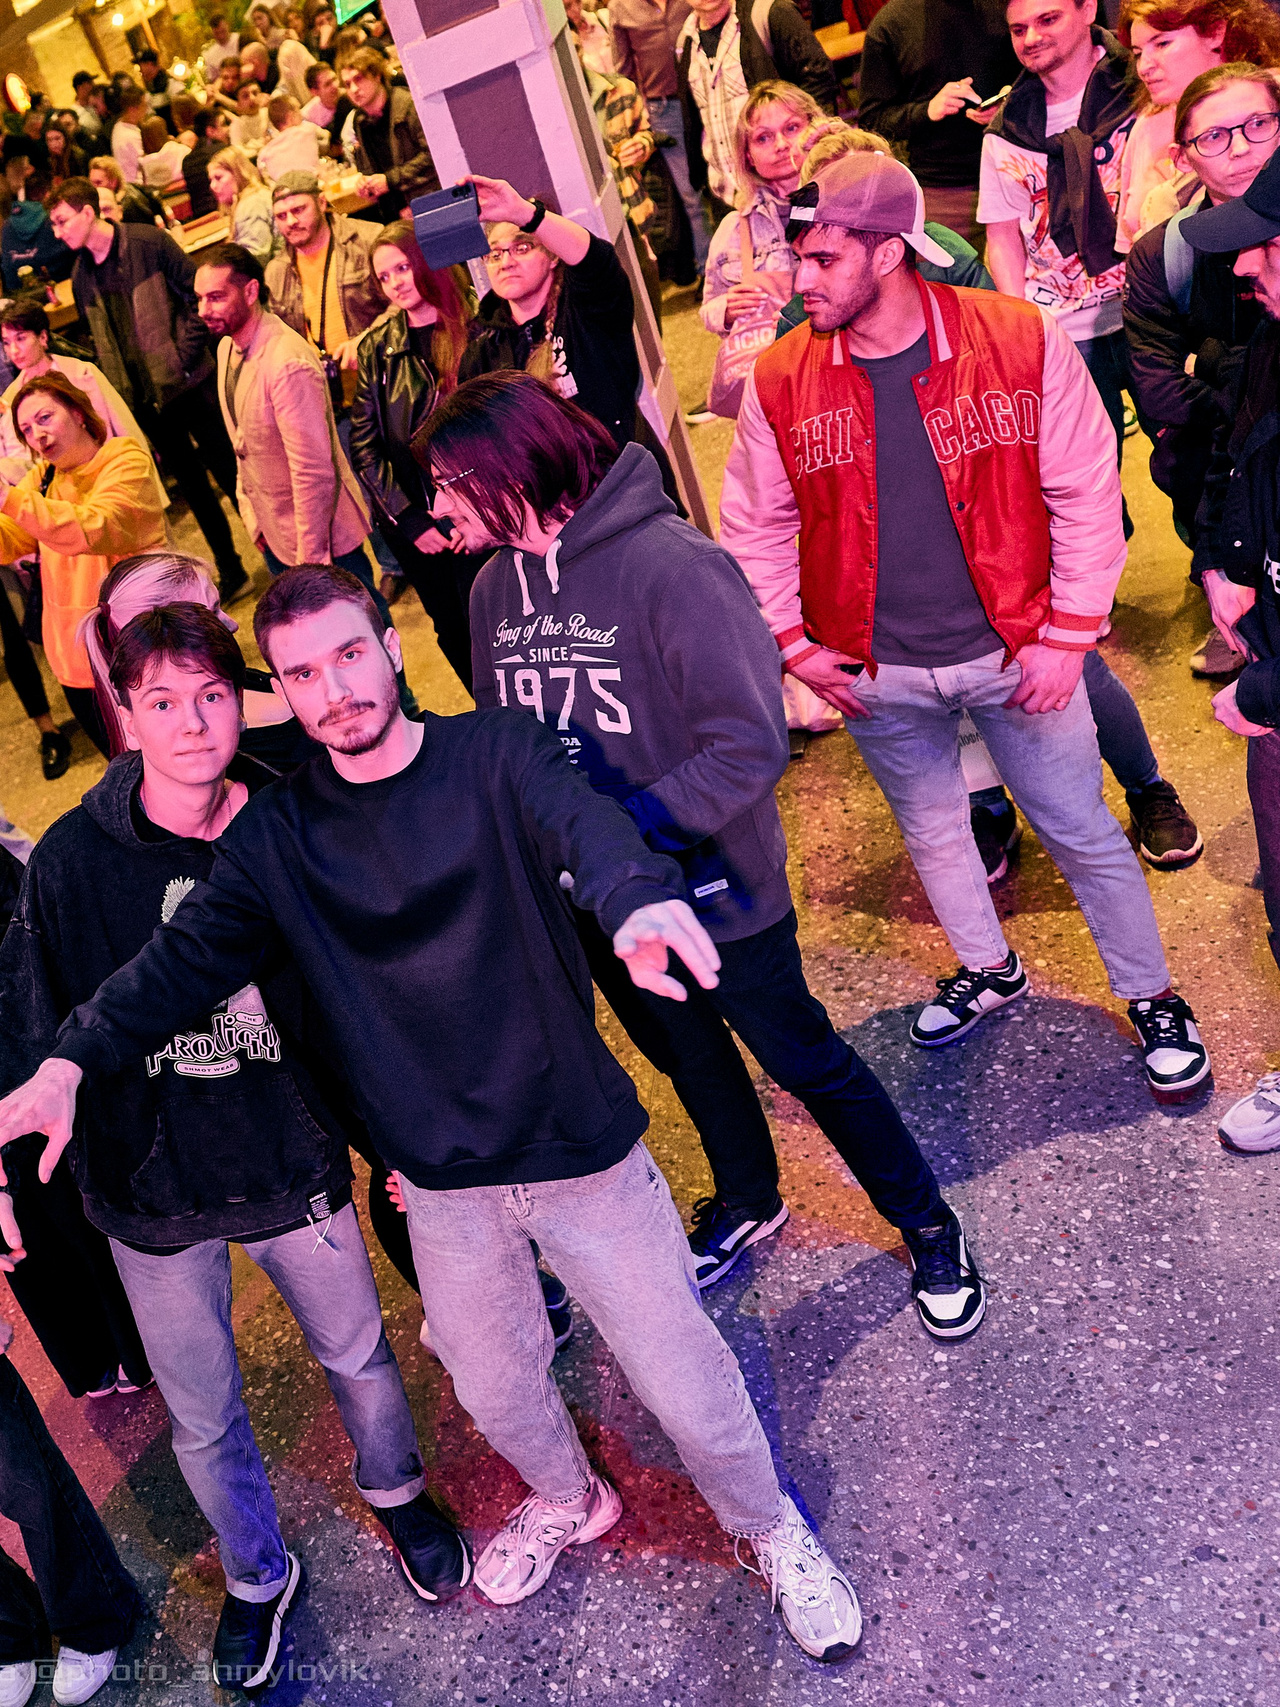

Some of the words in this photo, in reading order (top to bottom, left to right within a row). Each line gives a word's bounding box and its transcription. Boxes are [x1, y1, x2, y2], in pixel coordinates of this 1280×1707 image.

[923, 389, 1041, 465] CAGO
[522, 615, 542, 645] of
[540, 614, 563, 636] the
[565, 613, 619, 648] Road
[528, 646, 569, 664] SINCE
[494, 666, 632, 734] 1975
[213, 1062, 235, 1072] WEAR
